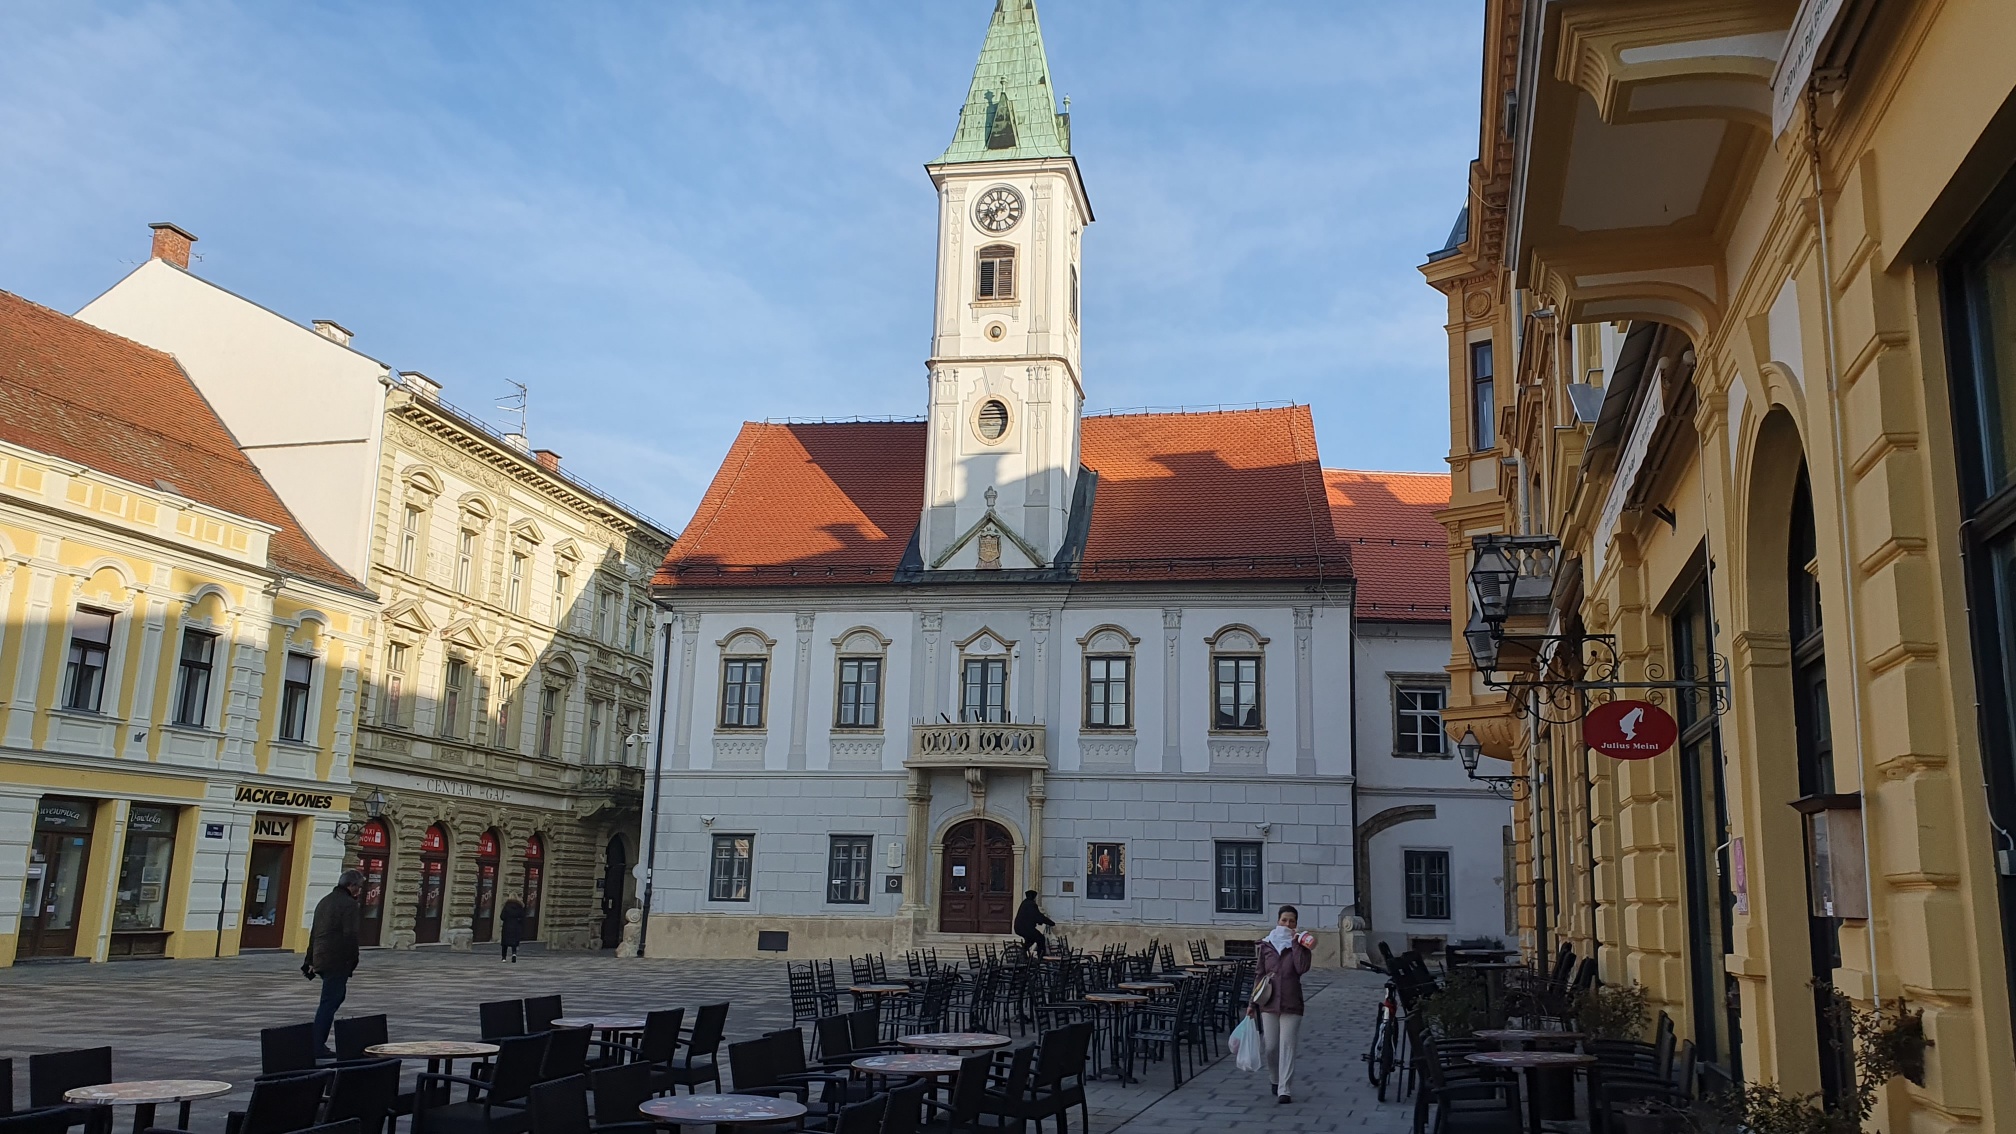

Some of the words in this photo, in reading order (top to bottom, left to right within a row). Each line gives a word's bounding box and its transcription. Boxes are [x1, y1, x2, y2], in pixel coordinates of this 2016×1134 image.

[235, 787, 274, 804] JACK
[286, 793, 333, 809] JONES
[426, 779, 472, 797] CENTAR
